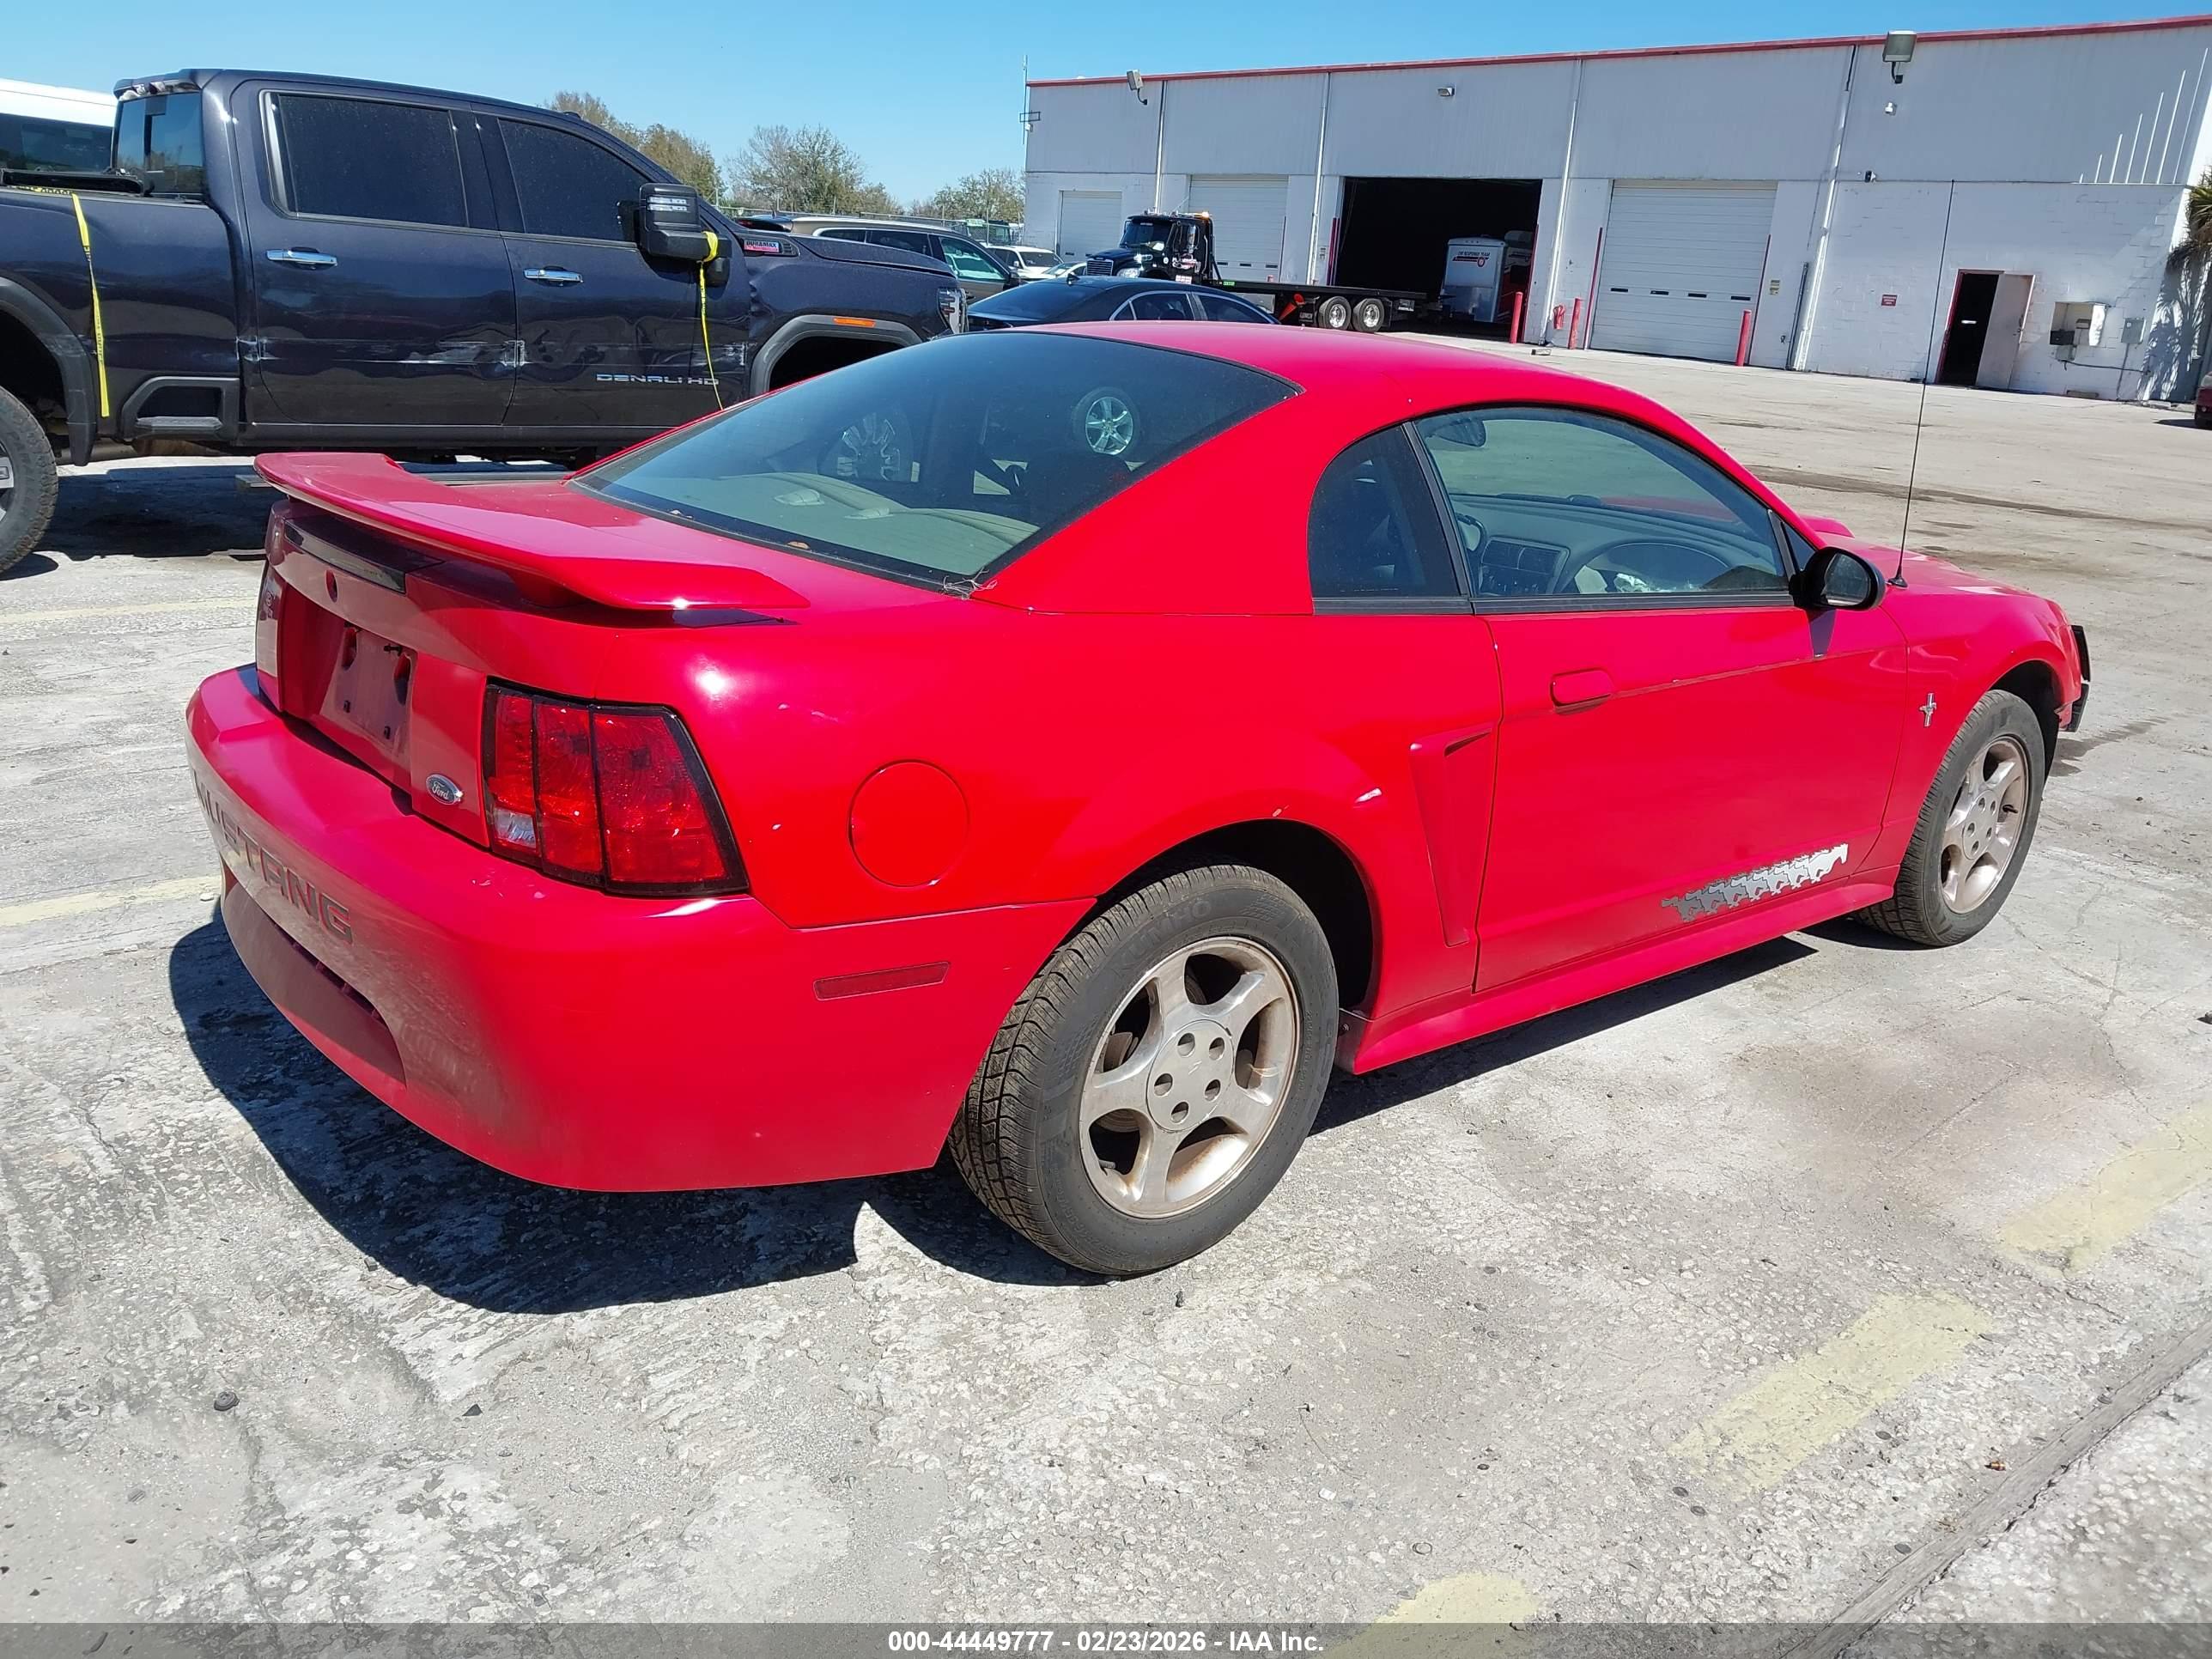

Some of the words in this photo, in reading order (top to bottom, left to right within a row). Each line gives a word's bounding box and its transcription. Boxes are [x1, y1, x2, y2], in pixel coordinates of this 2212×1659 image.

[596, 374, 683, 384] DENALI
[688, 377, 719, 386] HD
[431, 781, 450, 800] Ford
[194, 769, 353, 944] MUSTANG
